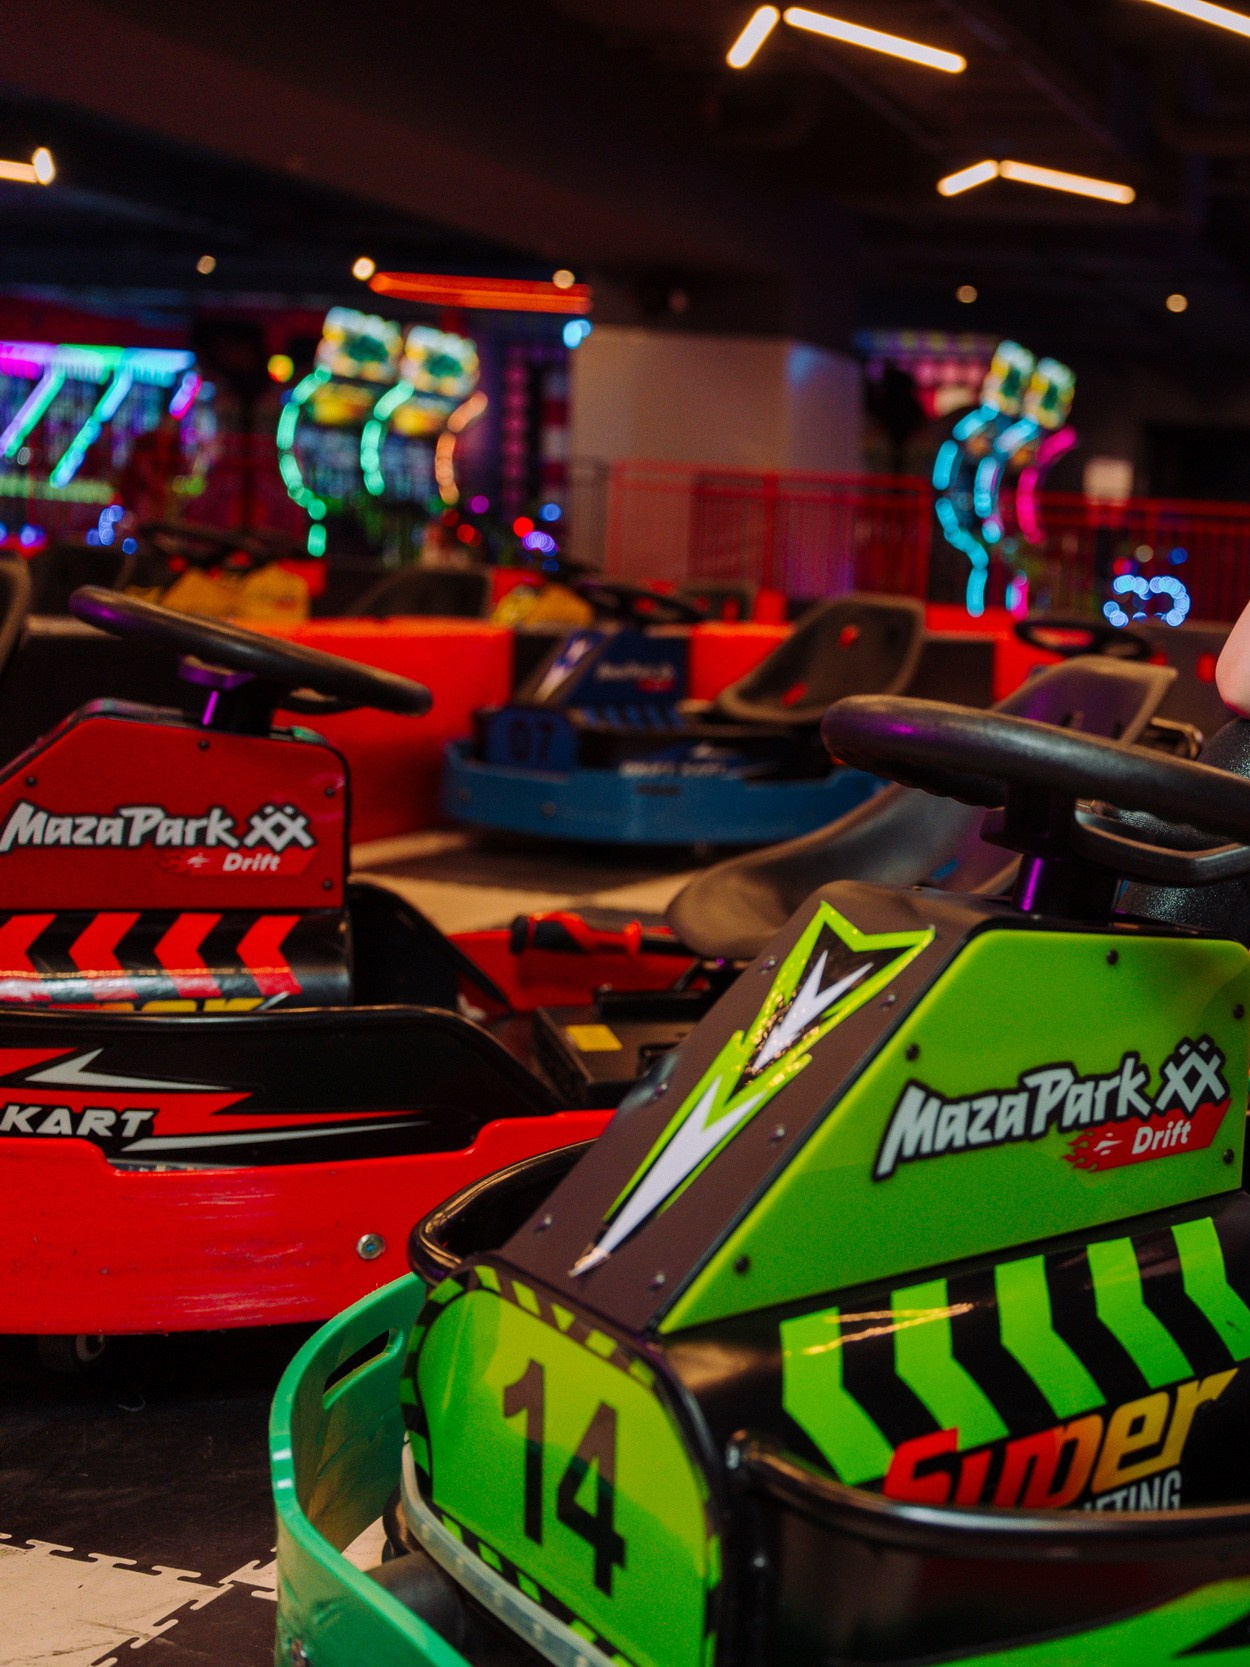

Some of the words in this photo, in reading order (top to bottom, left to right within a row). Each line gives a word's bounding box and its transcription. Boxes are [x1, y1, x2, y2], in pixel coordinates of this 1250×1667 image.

[0, 801, 240, 850] MazaPark
[222, 852, 281, 872] Drift
[0, 1104, 155, 1138] KART
[876, 1058, 1151, 1176] MazaPark
[1132, 1120, 1192, 1155] Drift
[503, 1358, 626, 1598] 14
